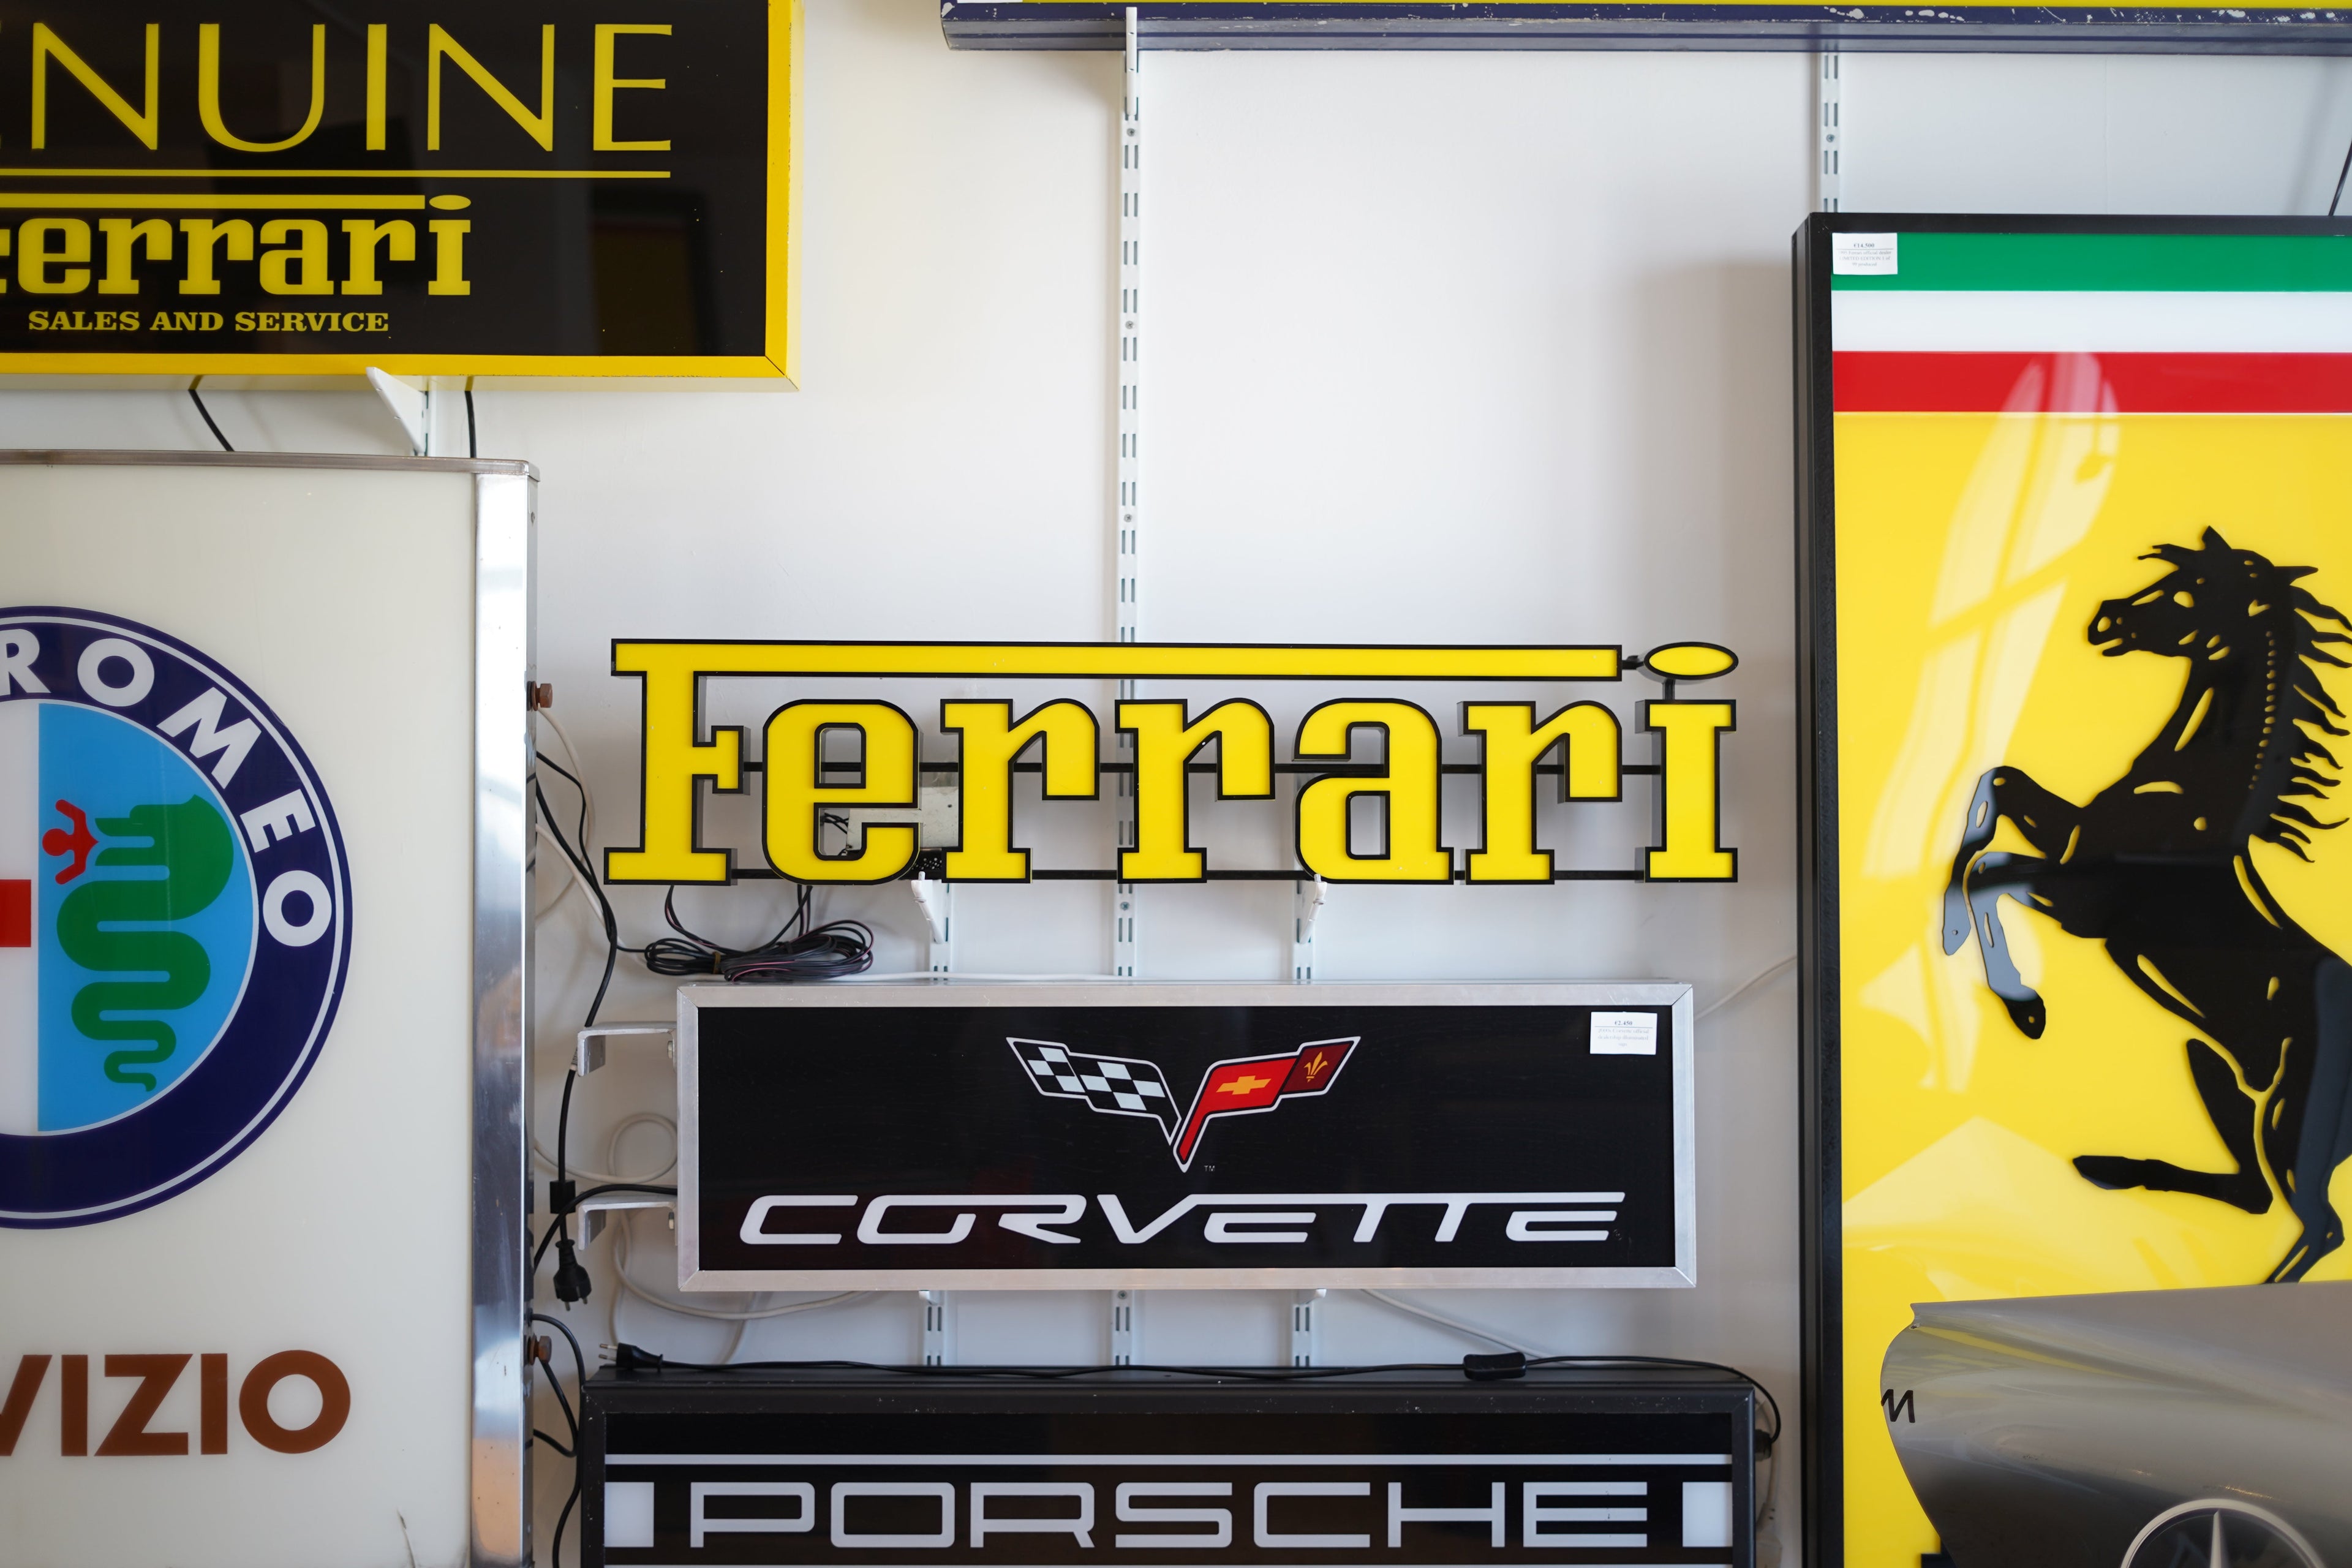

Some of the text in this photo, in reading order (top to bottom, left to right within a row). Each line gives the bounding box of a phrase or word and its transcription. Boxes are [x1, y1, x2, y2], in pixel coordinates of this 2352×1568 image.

[0, 22, 673, 153] NUINE
[28, 311, 389, 333] SALES AND SERVICE
[0, 628, 333, 948] ROMEO
[603, 639, 1738, 886] Ferrari
[740, 1191, 1626, 1245] CORVETTE
[690, 1482, 1648, 1548] PORSCHE
